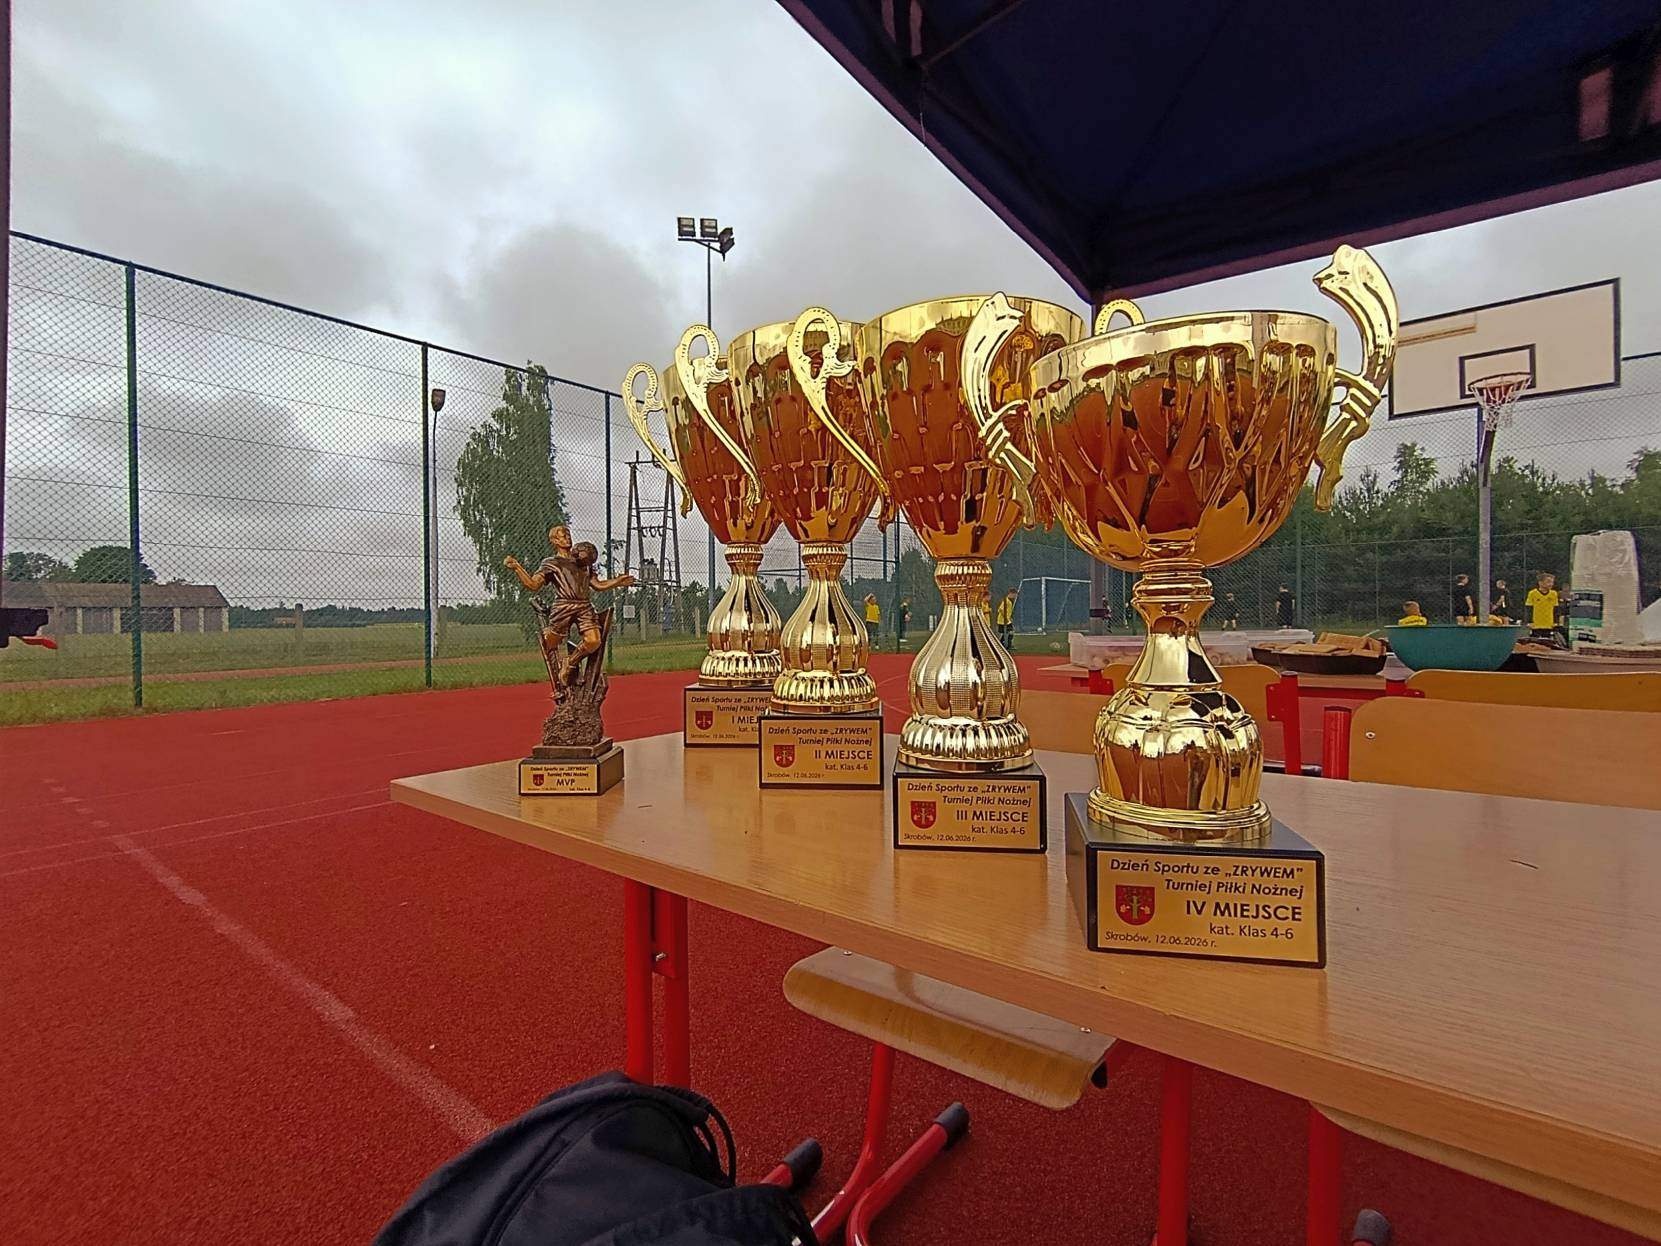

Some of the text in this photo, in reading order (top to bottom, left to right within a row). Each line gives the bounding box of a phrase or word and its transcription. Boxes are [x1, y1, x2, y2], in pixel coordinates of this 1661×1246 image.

[737, 716, 758, 724] MIEJ
[768, 726, 790, 735] Dzień
[792, 727, 817, 736] Sportu
[799, 737, 872, 746] Turniej Piłki Nożnej
[815, 750, 872, 760] II MIEJSCE
[557, 778, 575, 786] MVP
[907, 782, 932, 792] Dzień
[935, 783, 965, 794] Sportu
[982, 784, 1031, 794] „ZRYWEM”
[942, 795, 1032, 807] Turniej Piłki Nożnej
[956, 810, 1028, 822] III MIEJSCE
[971, 825, 1025, 835] kat. Klas 4-6
[1110, 858, 1303, 879] Dzień Sportu ze „ZRYWEM”
[1165, 878, 1304, 899] Turniej Piłki Nożnej
[1186, 900, 1302, 922] IV MIEJSCE
[1210, 923, 1294, 940] kat. Klas 4-6
[1105, 931, 1217, 948] Skrobów, 12.06.2026 r.
